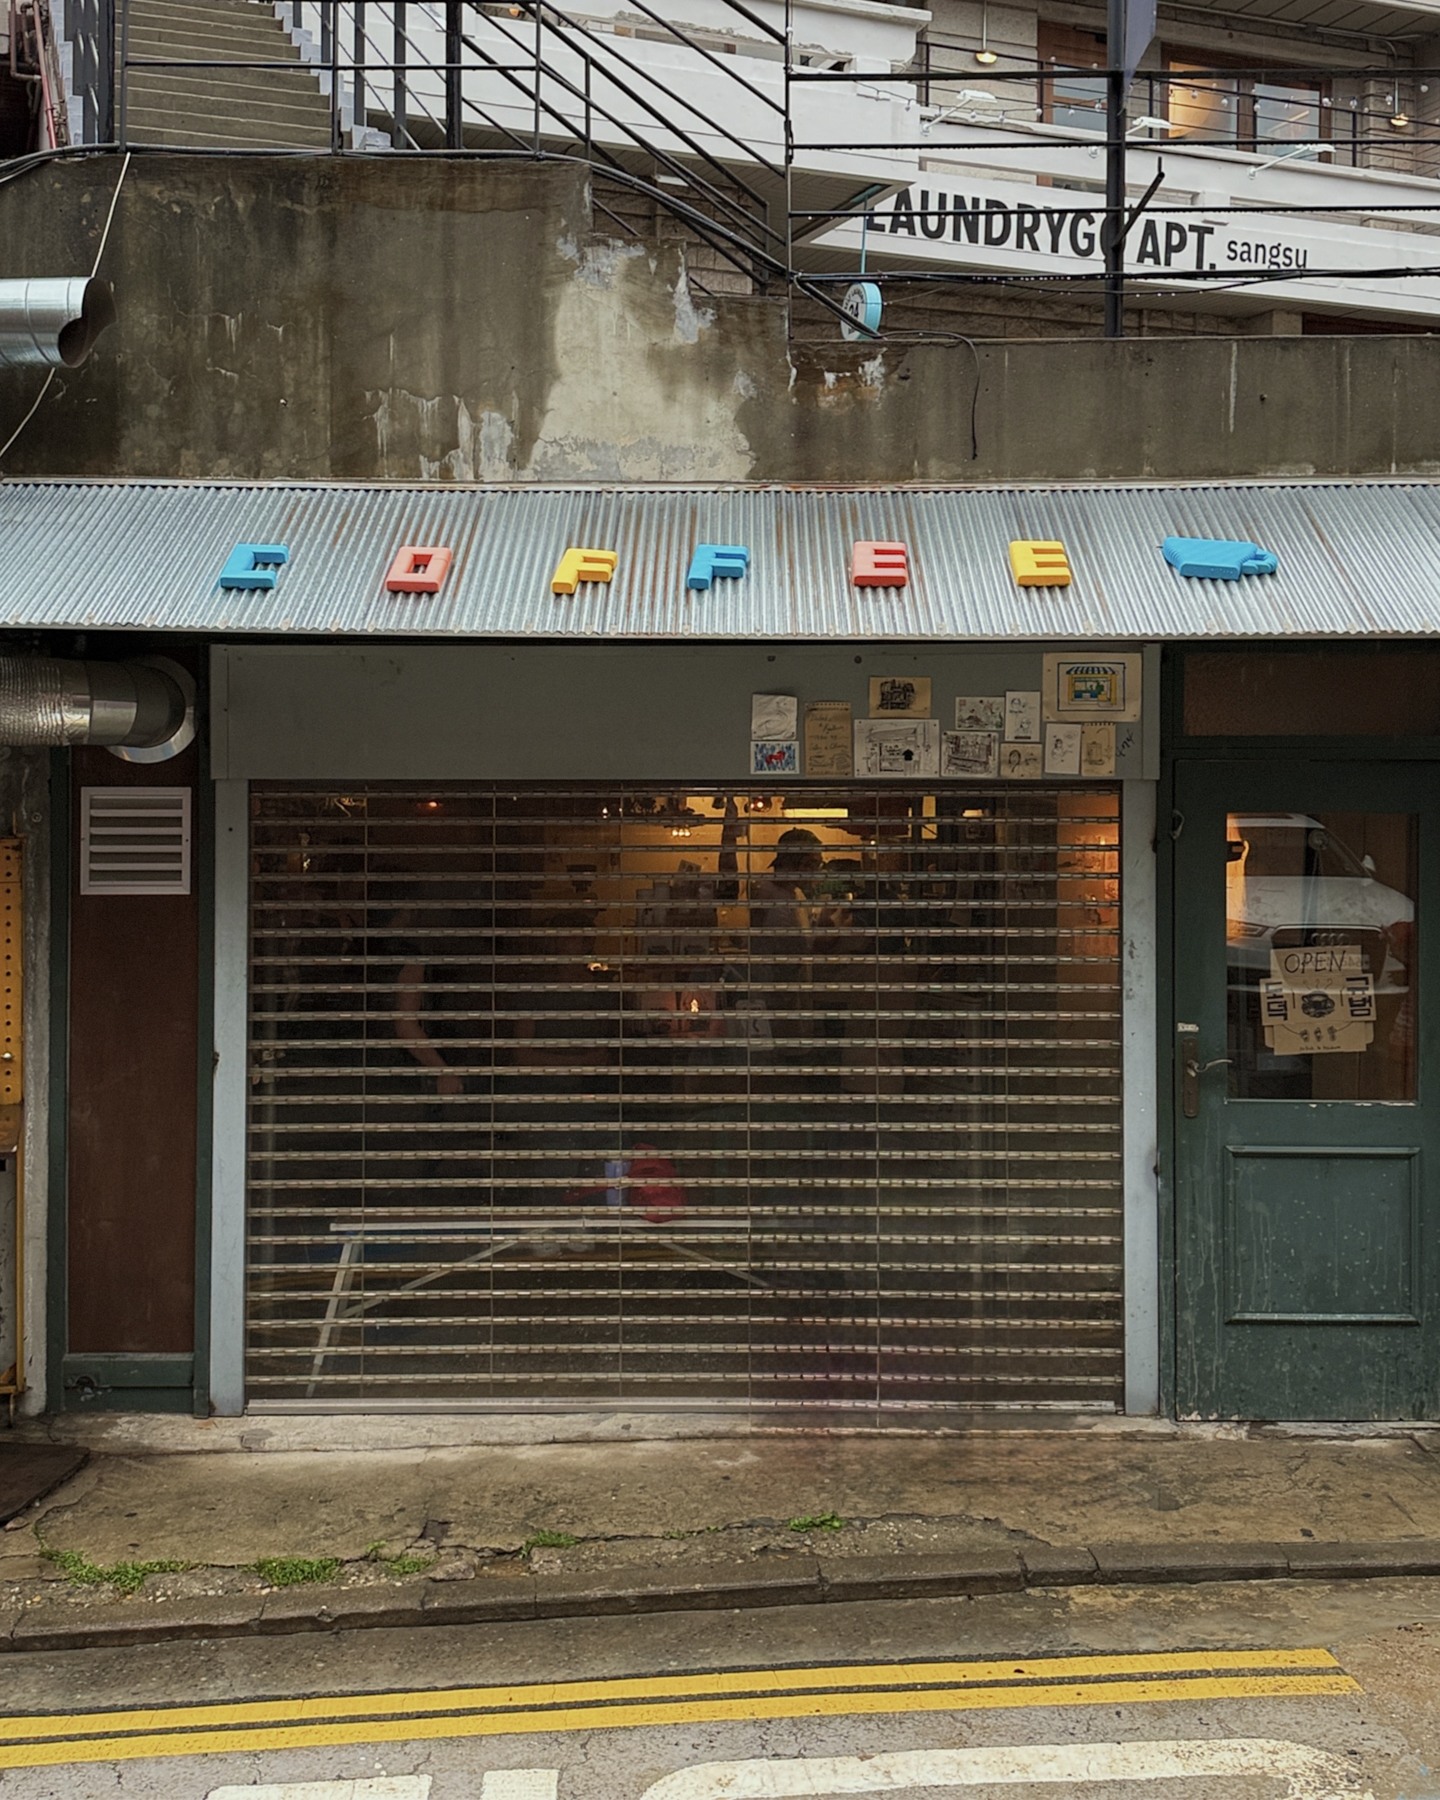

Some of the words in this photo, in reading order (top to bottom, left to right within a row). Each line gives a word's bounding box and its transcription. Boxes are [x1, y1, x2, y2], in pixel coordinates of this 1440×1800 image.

[1137, 219, 1216, 271] APT.
[1226, 240, 1307, 269] sangsu
[219, 540, 1072, 595] COFFEE
[1284, 950, 1346, 974] OPEN
